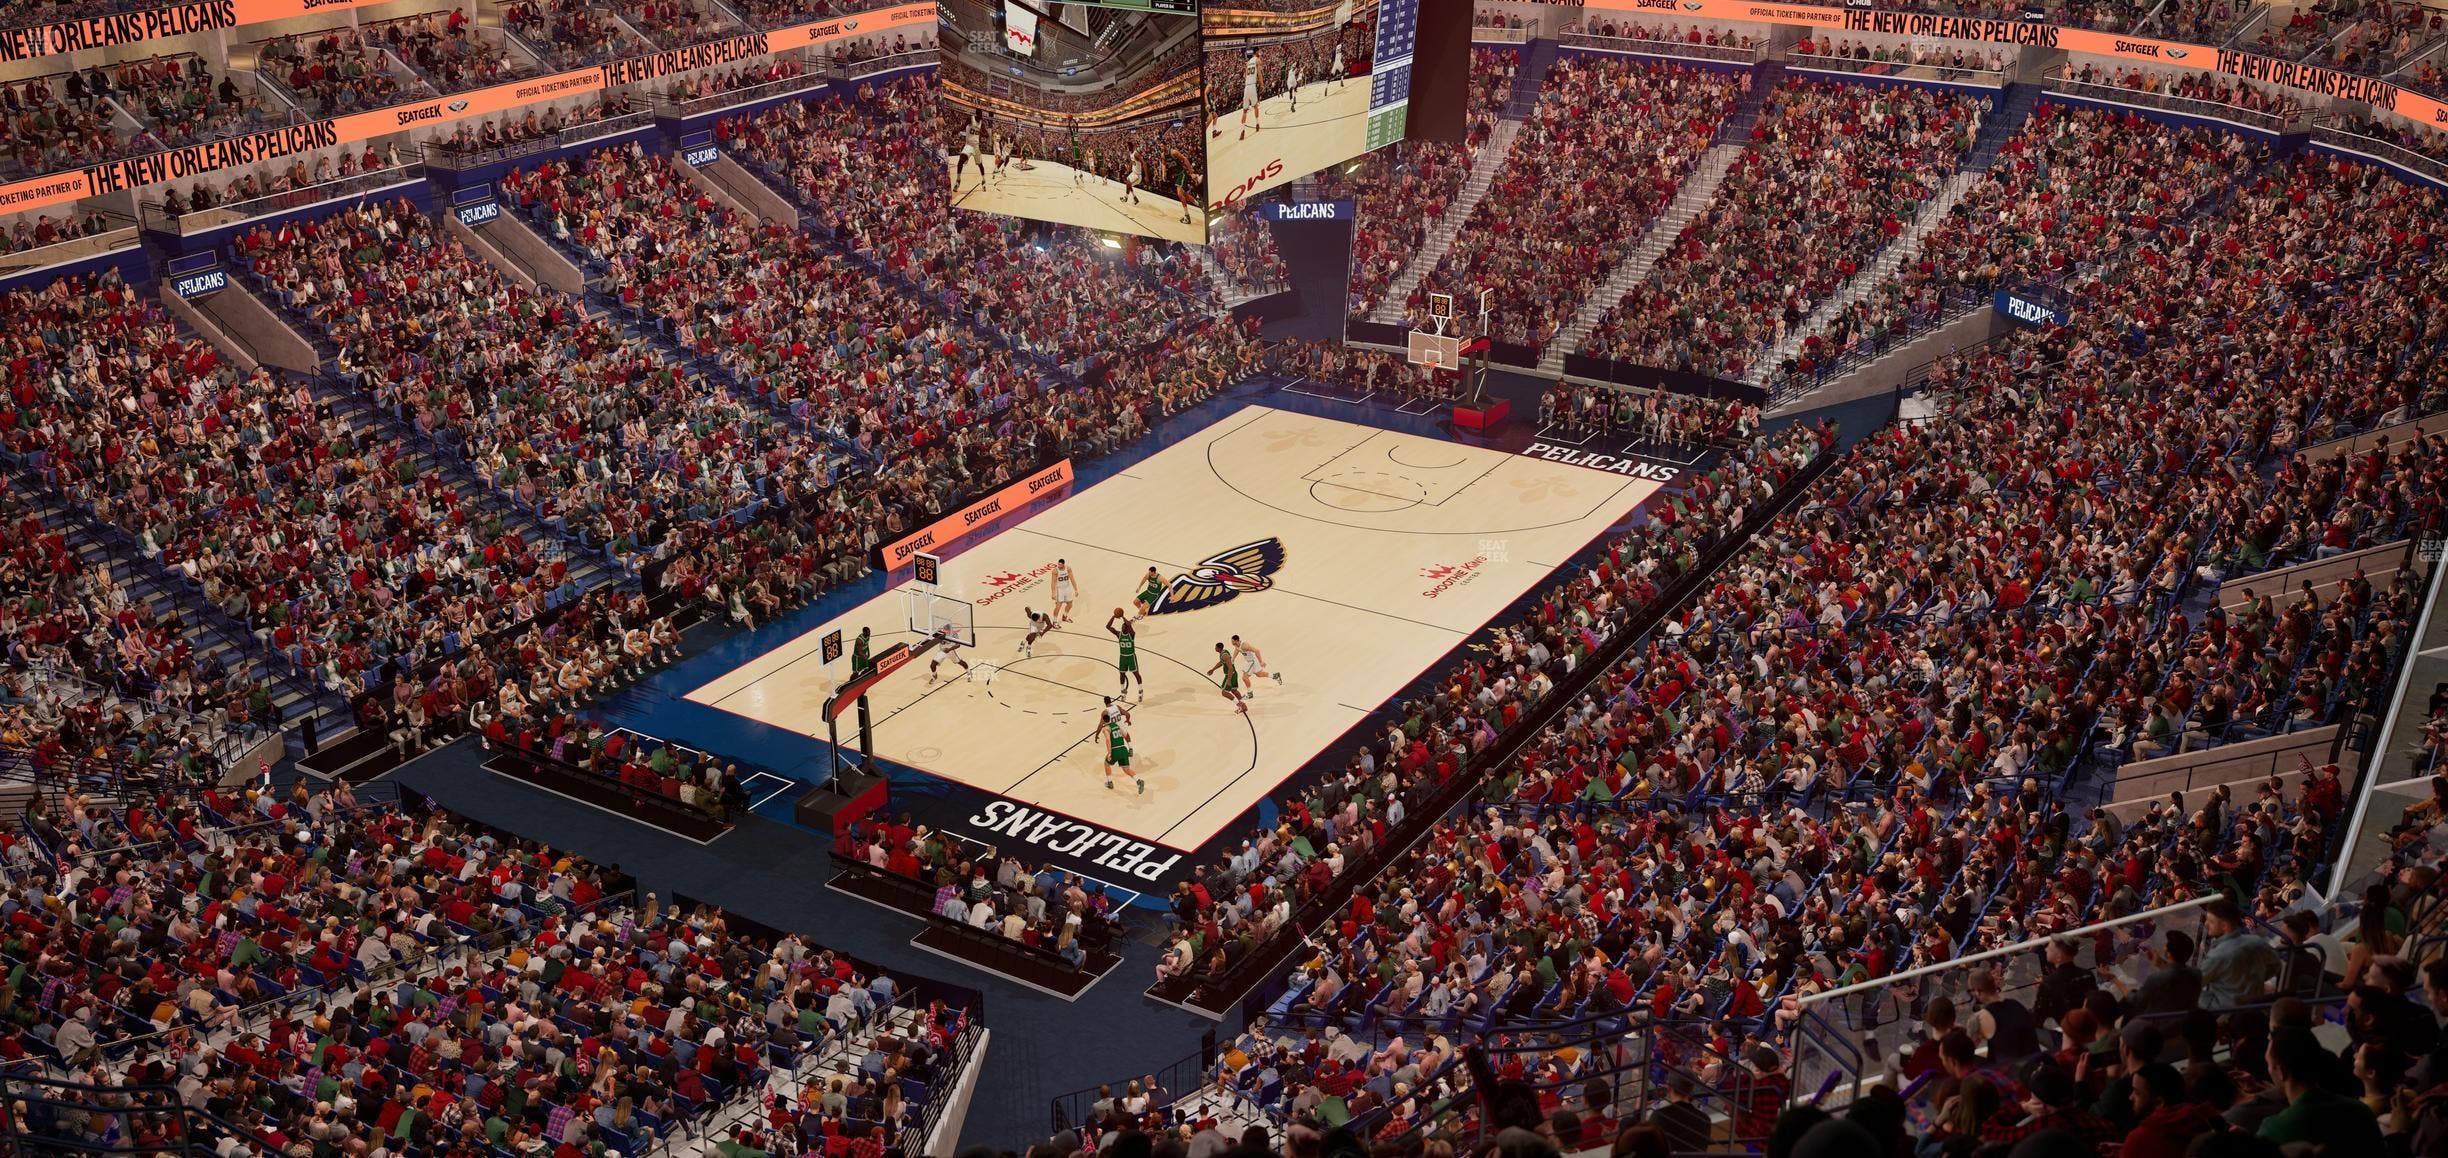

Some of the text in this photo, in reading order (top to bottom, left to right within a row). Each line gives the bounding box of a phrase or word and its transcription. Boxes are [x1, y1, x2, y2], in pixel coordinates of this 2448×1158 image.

[891, 8, 935, 21] OFFICIAL TICKETING
[0, 0, 236, 62] NEW ORLEANS PELICANS
[809, 23, 840, 40] SEATGEEK
[1750, 8, 1774, 17] OFFICIAL
[1776, 10, 1806, 19] TICKETING
[1807, 13, 1833, 21] PARTNER
[1844, 10, 1869, 31] THE
[1872, 13, 1906, 34] NEW
[1911, 15, 1981, 41] ORLEANS
[1984, 21, 2058, 48] PELICANS
[601, 33, 769, 88] THE NEW ORLEANS PELICANS
[2115, 40, 2159, 57] SEATGEEK
[516, 73, 600, 99] OFFICIAL TICKETING PARTNER OF
[2217, 49, 2398, 112] THE NEW ORLEANS PELICANS
[397, 104, 442, 126] SEATGEEK
[36, 182, 71, 198] PARTNER
[72, 180, 82, 191] OF
[84, 166, 122, 196] THE
[124, 153, 167, 188] NEW
[169, 139, 254, 179] ORLEANS
[256, 120, 338, 161] PELICANS
[687, 147, 717, 166] PELICANS
[461, 203, 497, 223] PELICANS
[1278, 203, 1335, 219] PELICANS
[178, 271, 225, 297] PELICANS
[1435, 304, 1446, 315] 88
[1521, 442, 1679, 481] PELICANS
[1028, 467, 1063, 494] SEATGEEK
[964, 498, 1001, 526] SEATGEEK
[895, 531, 935, 561] SEATGEEK
[919, 567, 933, 580] 88
[1422, 569, 1468, 598] SMOOTHIE
[976, 577, 1032, 606] SMOOTHIE
[826, 643, 839, 660] 88
[880, 649, 906, 671] SEATGEEK
[969, 800, 1182, 881] PELICANS
